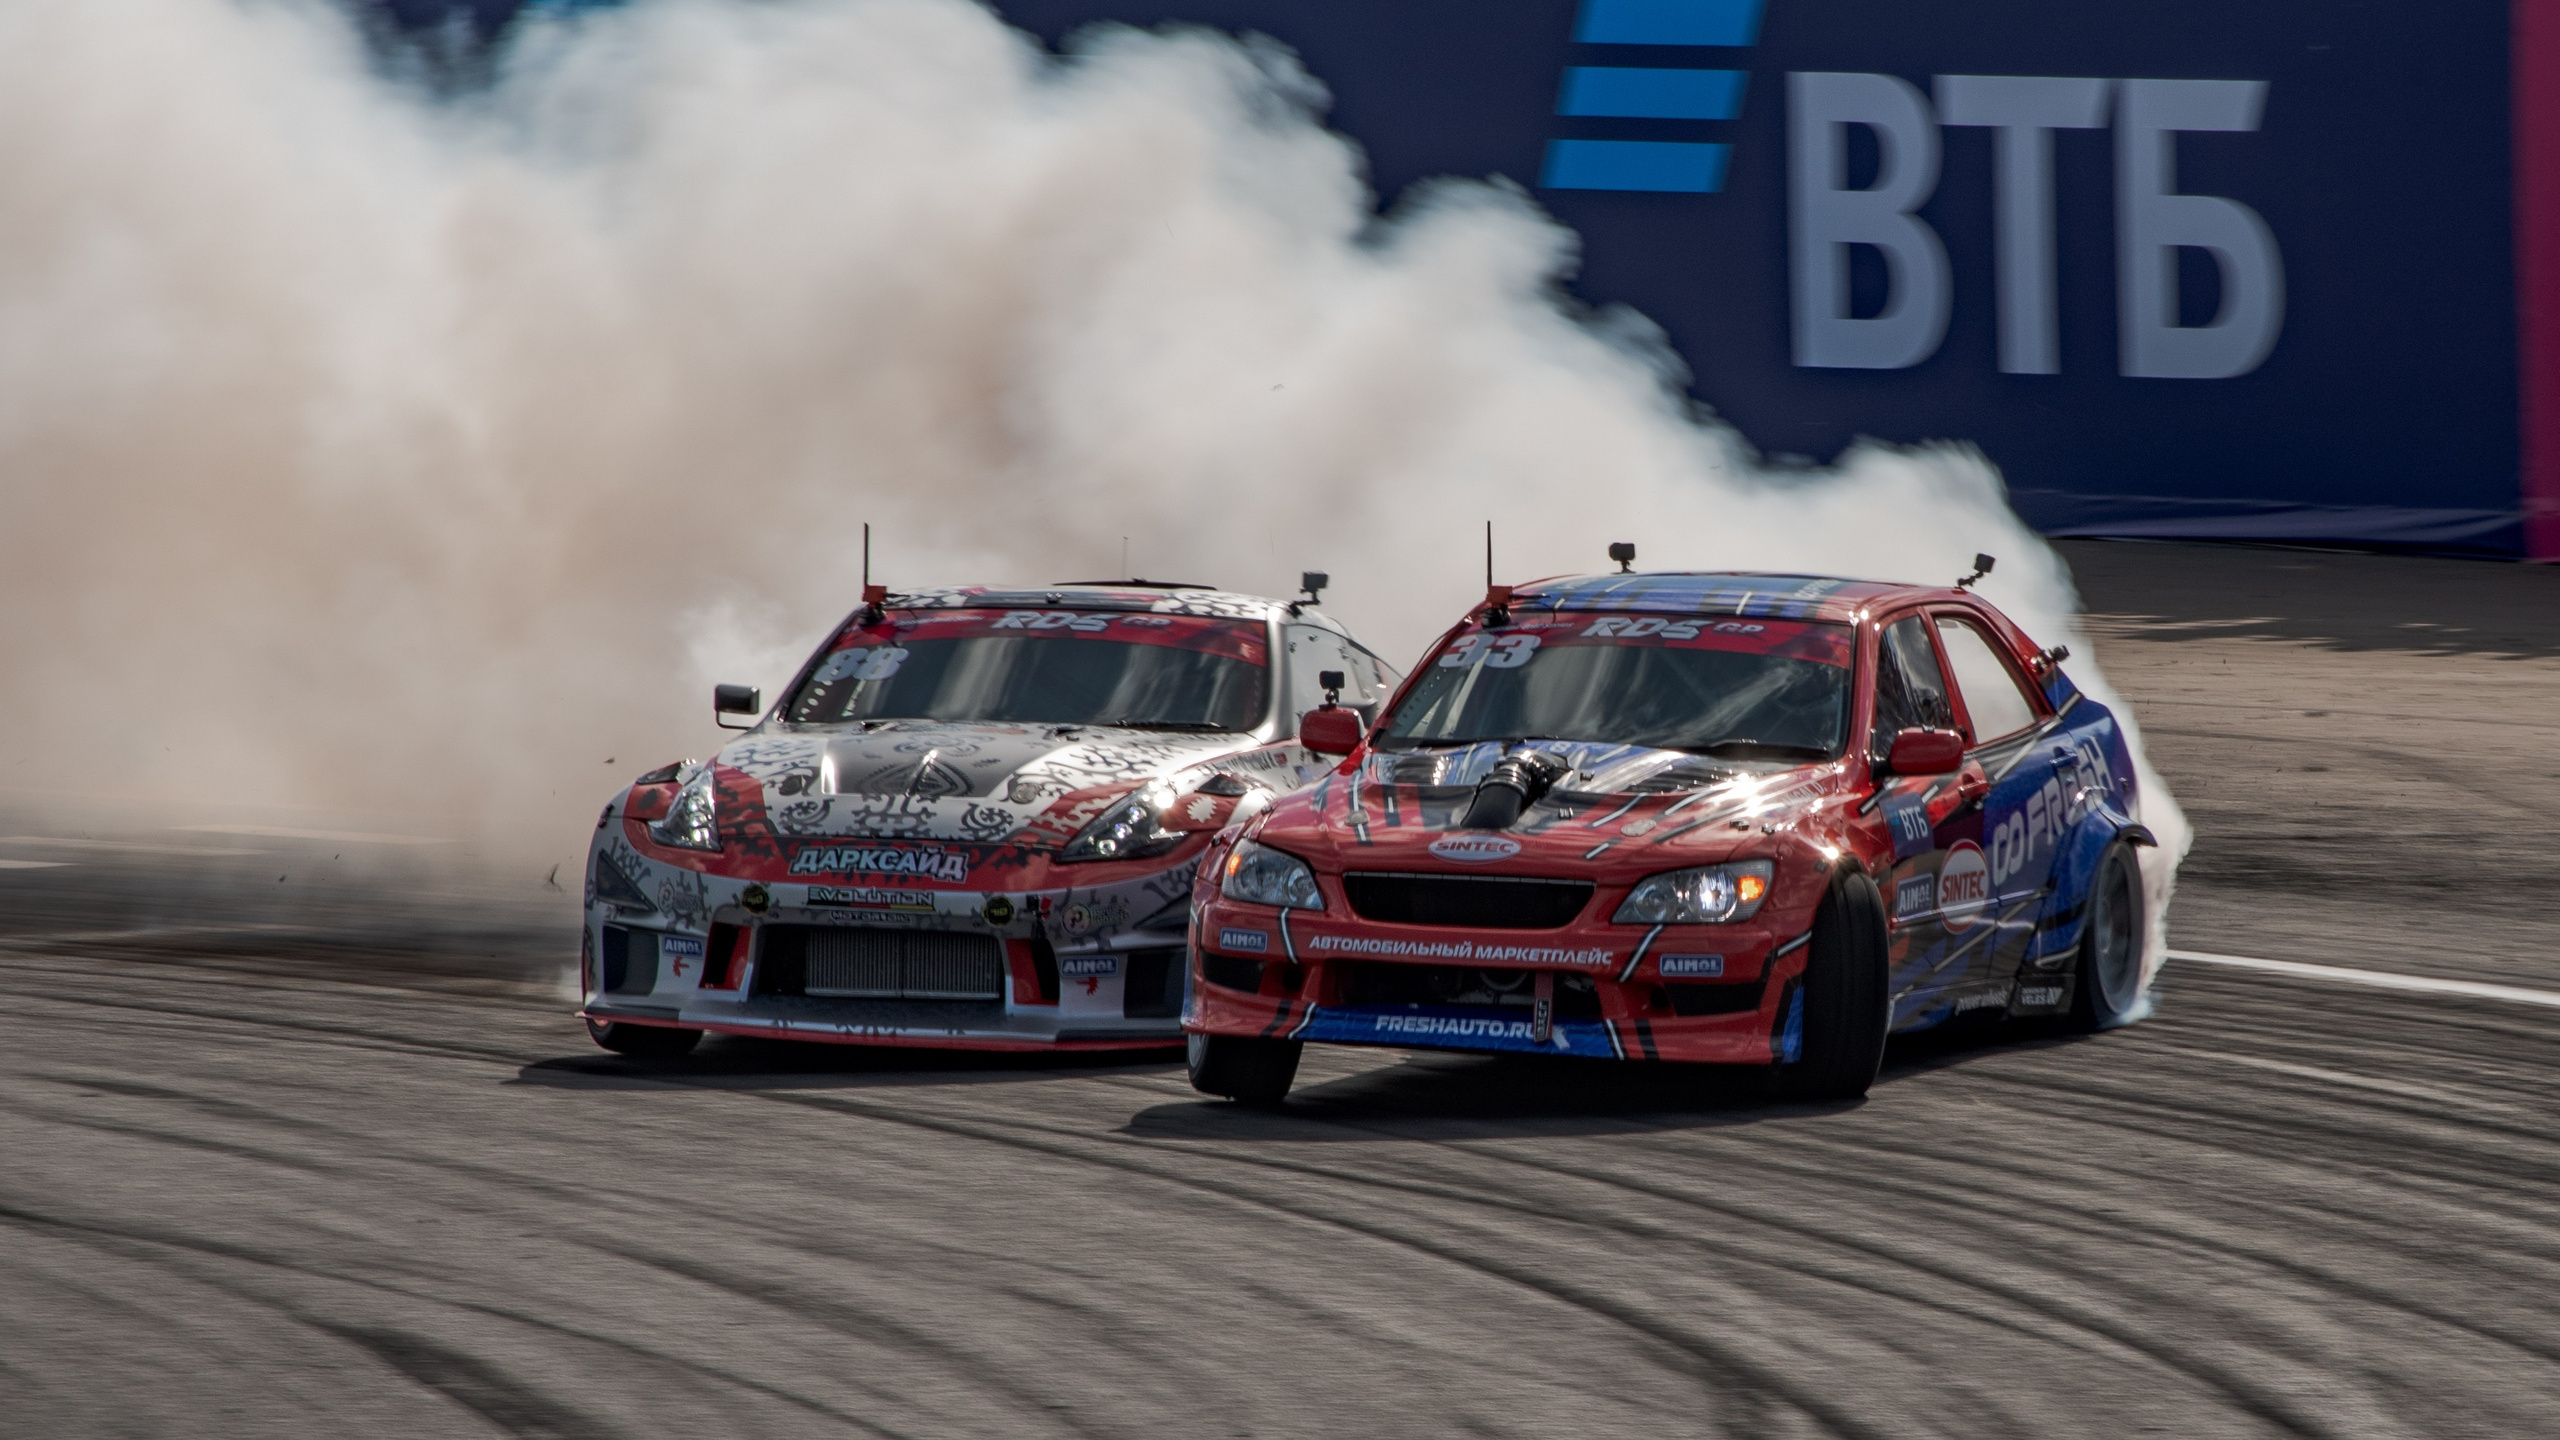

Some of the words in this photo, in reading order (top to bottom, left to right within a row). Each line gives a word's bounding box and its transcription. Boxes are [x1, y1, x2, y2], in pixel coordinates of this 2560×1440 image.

[1786, 71, 2287, 378] ВТБ
[991, 611, 1122, 631] RDS
[1580, 617, 1714, 639] RDS
[1713, 622, 1765, 634] GP
[813, 648, 909, 682] 88
[1439, 634, 1541, 668] 33
[1898, 807, 1928, 841] ВТБ
[1435, 840, 1514, 853] SINTEC
[790, 846, 966, 882] ДАРКСАЙД
[809, 887, 933, 905] EVOLUTION
[1941, 870, 1985, 904] SINTEC
[1222, 932, 1265, 948] AIMOL
[1309, 936, 1474, 958] АВТОМОБИЛЬНЫЙ
[1475, 944, 1613, 965] МАРКЕТПЛЕЙС
[1663, 957, 1721, 973] AIMOL
